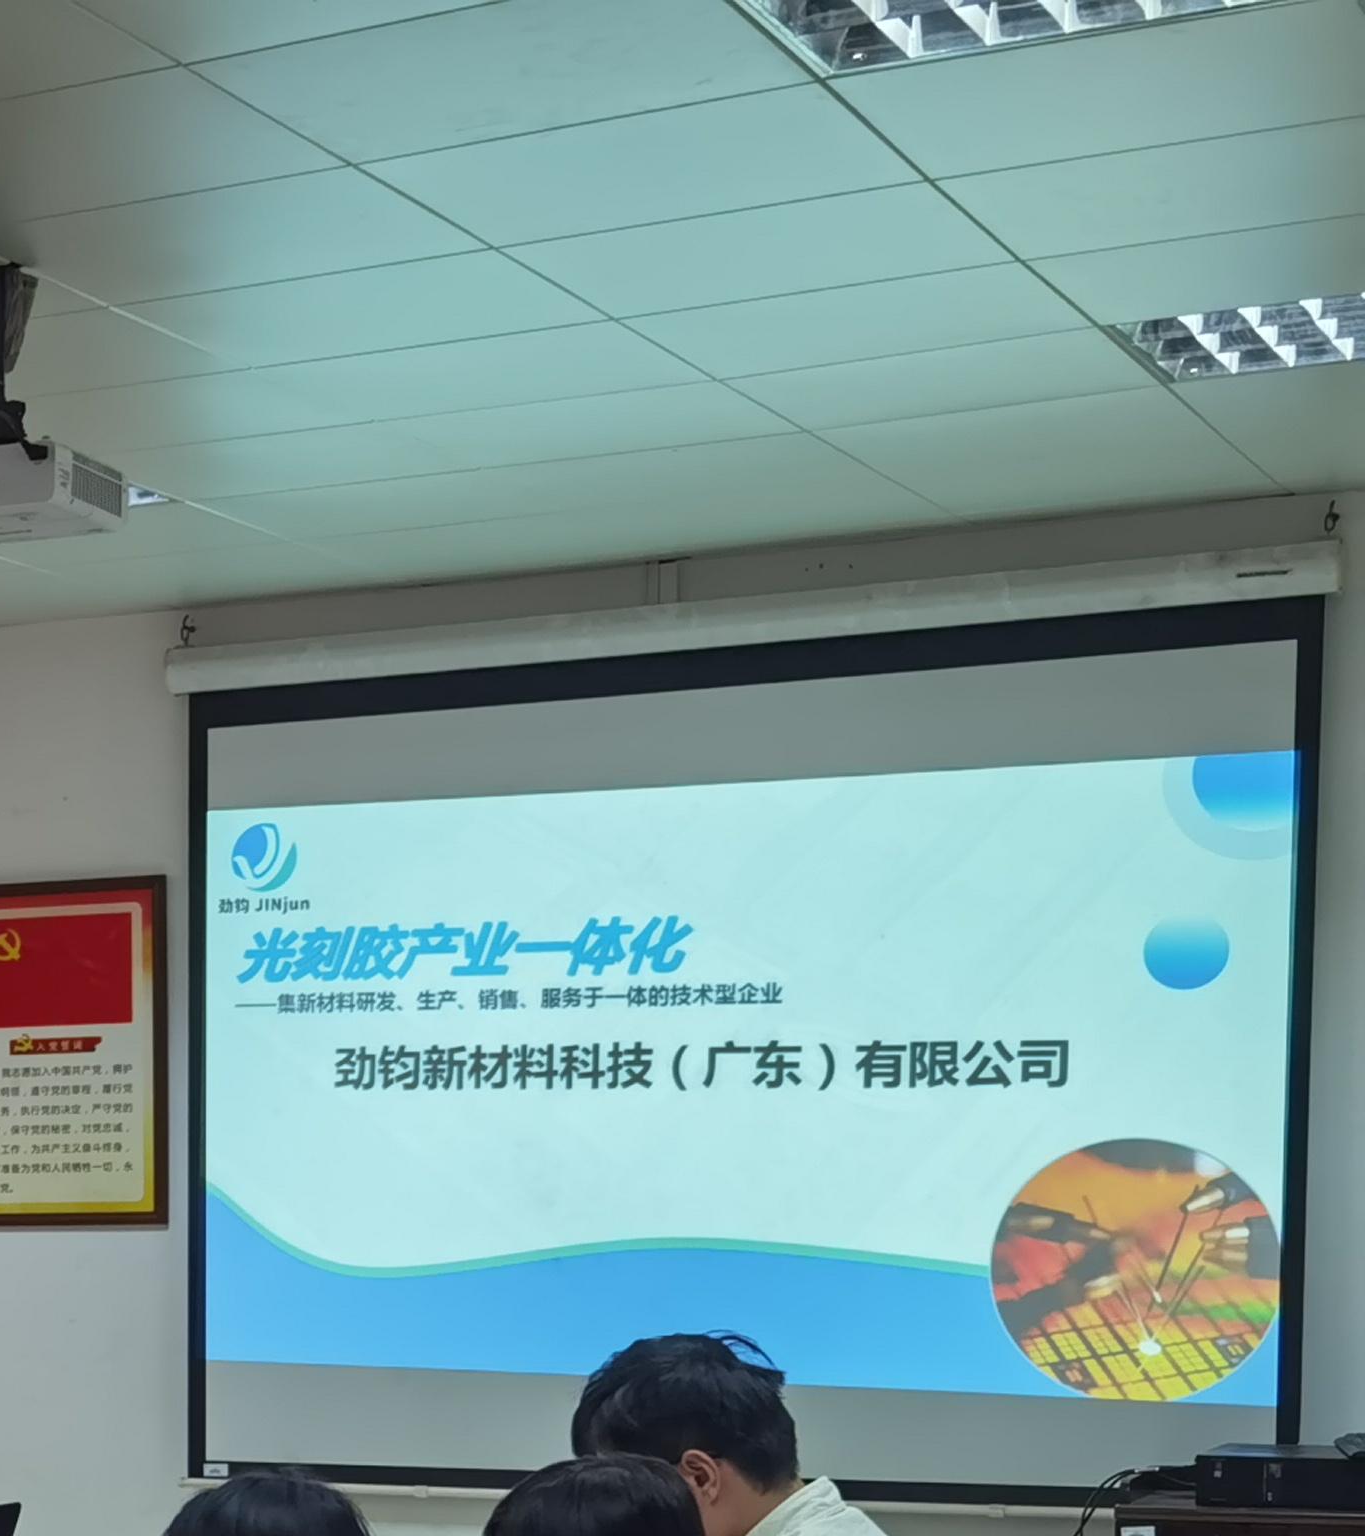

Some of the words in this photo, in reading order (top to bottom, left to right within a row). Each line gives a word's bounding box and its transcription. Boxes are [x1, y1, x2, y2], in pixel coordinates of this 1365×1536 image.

[255, 896, 310, 914] JINjun
[237, 916, 694, 985] 光刻胶产业一体化
[333, 1039, 1070, 1092] 劲钧新材料科技（广东）有限公司
